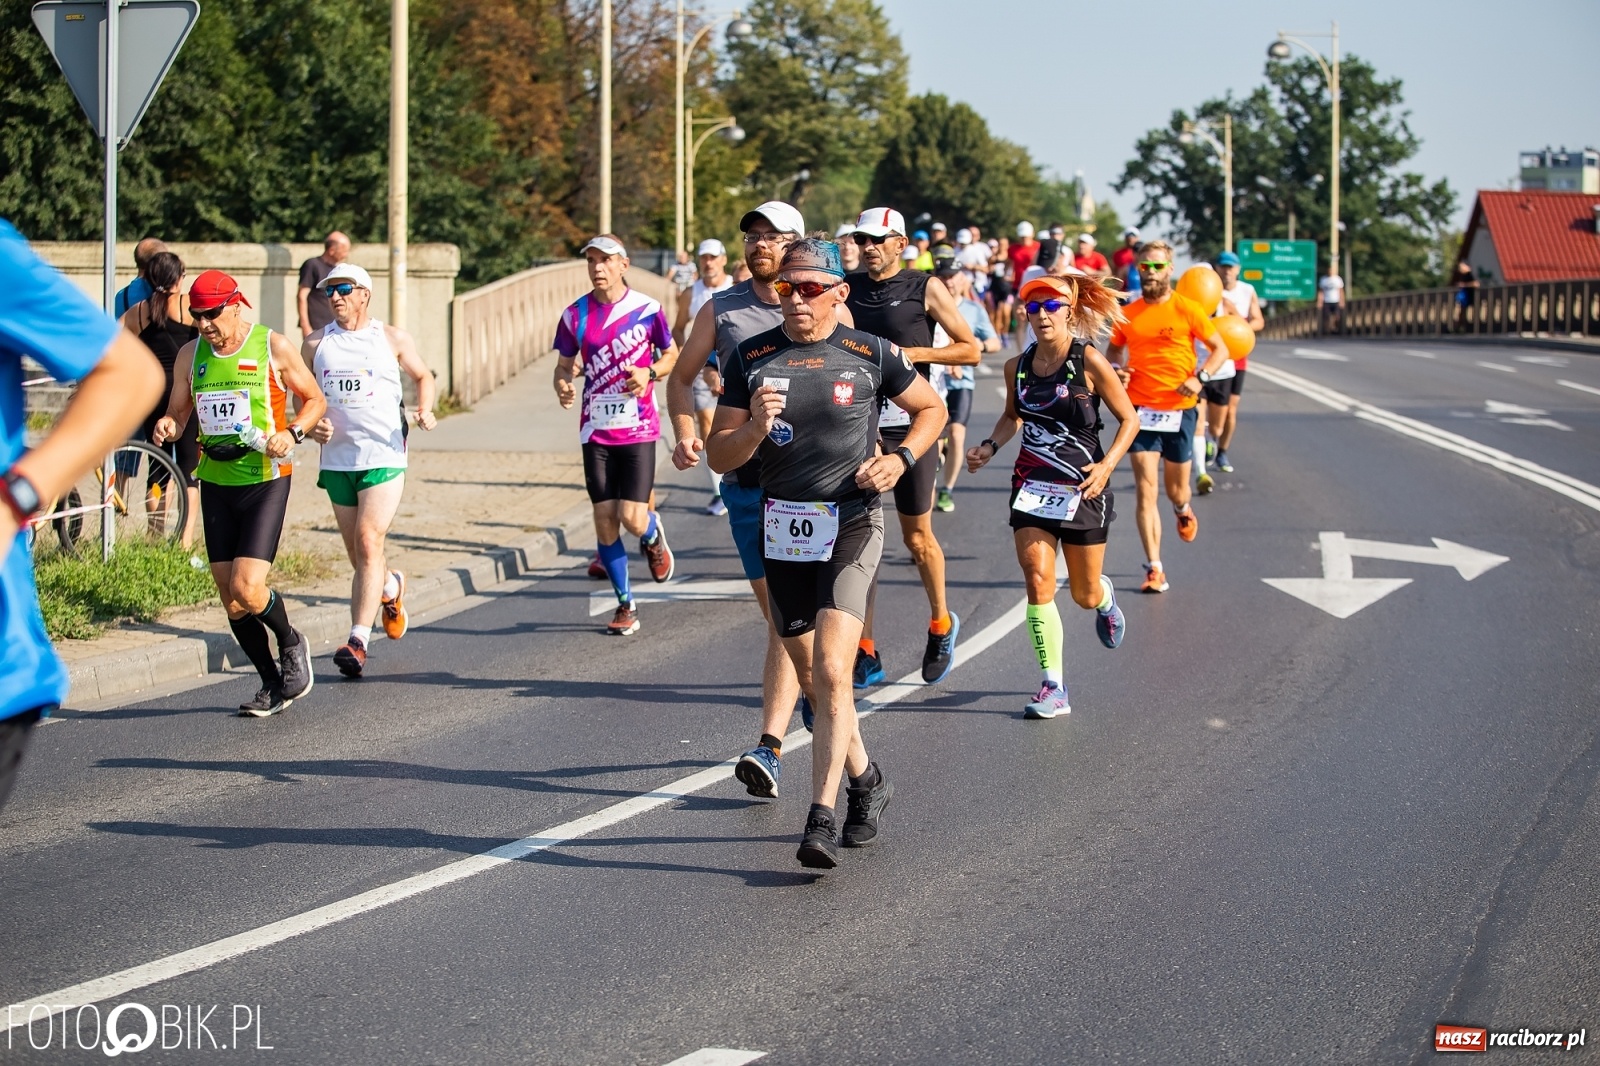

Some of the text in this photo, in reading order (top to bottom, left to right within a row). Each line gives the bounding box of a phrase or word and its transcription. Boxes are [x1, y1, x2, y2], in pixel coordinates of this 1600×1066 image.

[746, 344, 777, 360] Malibu
[842, 338, 873, 357] Malibu
[839, 371, 857, 379] 4F
[338, 379, 361, 392] 103
[212, 402, 236, 418] 147
[604, 403, 626, 416] 172
[1039, 494, 1066, 507] 157
[789, 518, 814, 538] 60
